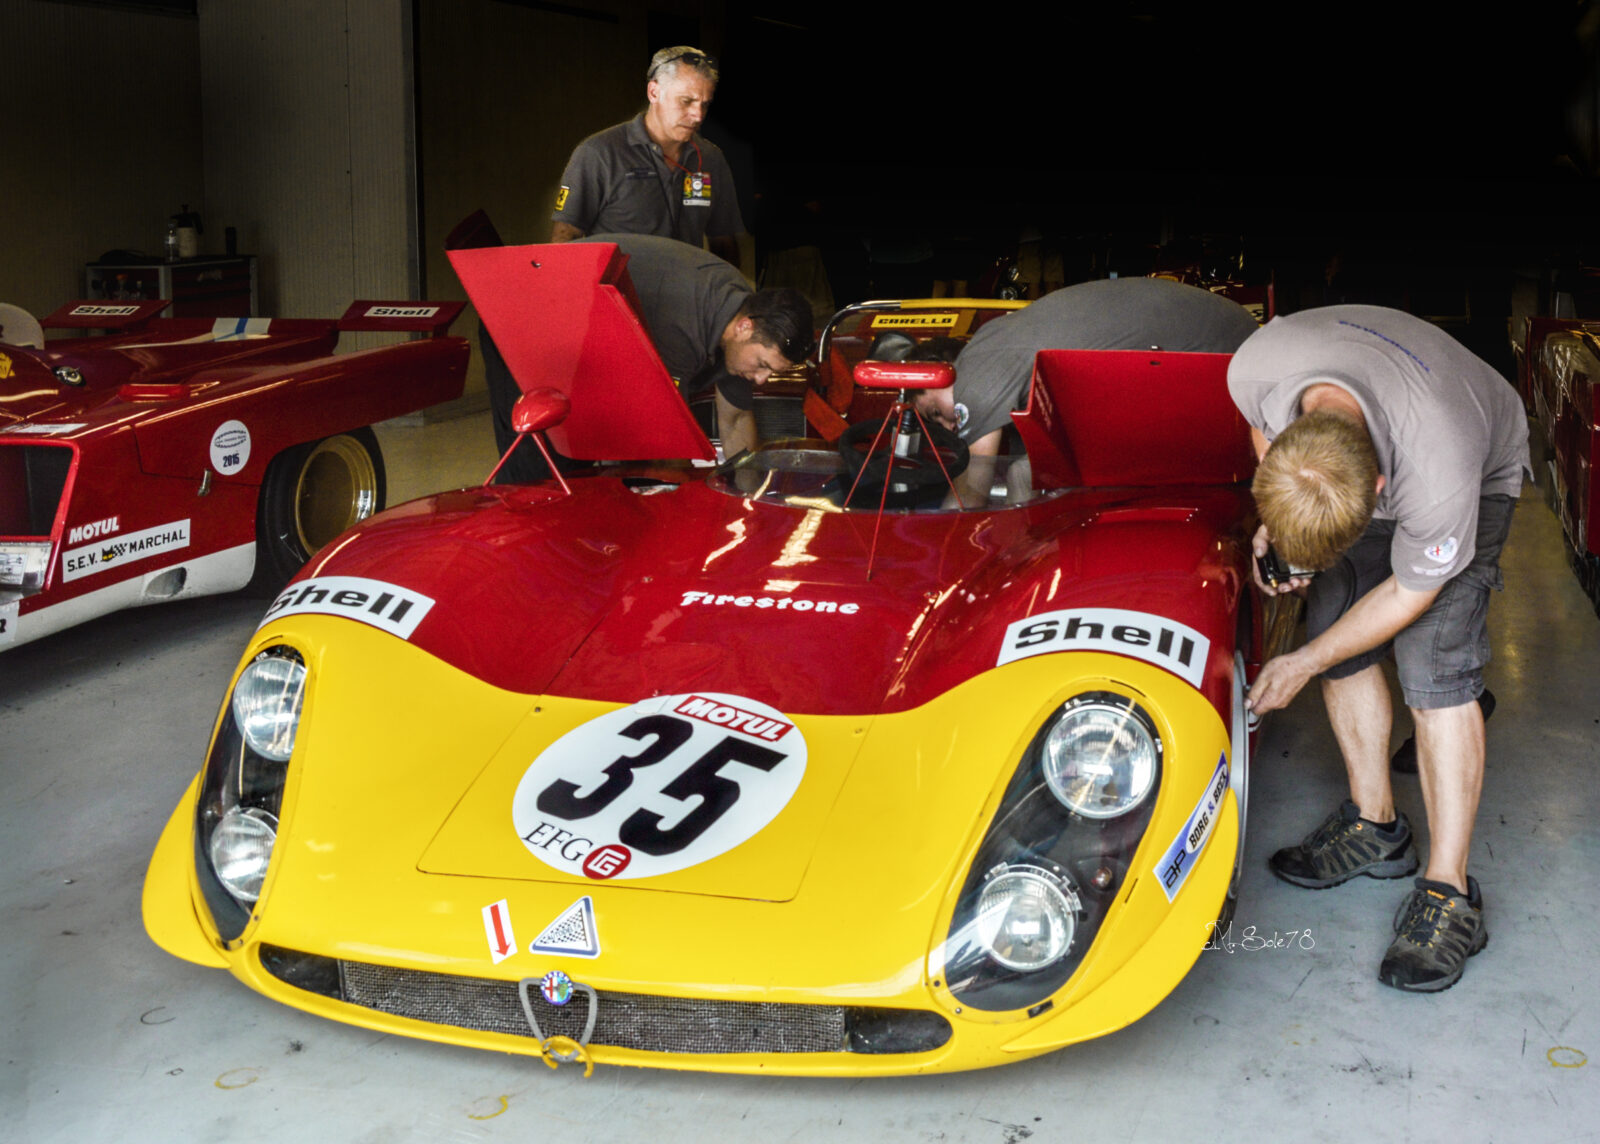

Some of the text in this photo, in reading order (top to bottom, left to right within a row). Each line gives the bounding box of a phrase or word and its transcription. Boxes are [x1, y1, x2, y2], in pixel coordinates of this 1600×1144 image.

[75, 306, 136, 314] Shell
[222, 453, 240, 467] 2015
[67, 529, 186, 572] S.E.V. MARCHAL
[68, 516, 120, 545] MOTUL
[265, 584, 414, 624] Shell
[680, 590, 860, 614] Firestone
[1015, 617, 1195, 668] Shell
[677, 698, 786, 739] MOTUL
[536, 714, 789, 856] 35
[521, 821, 594, 861] EFG
[1189, 812, 1209, 850] BORG
[1208, 801, 1215, 815] &
